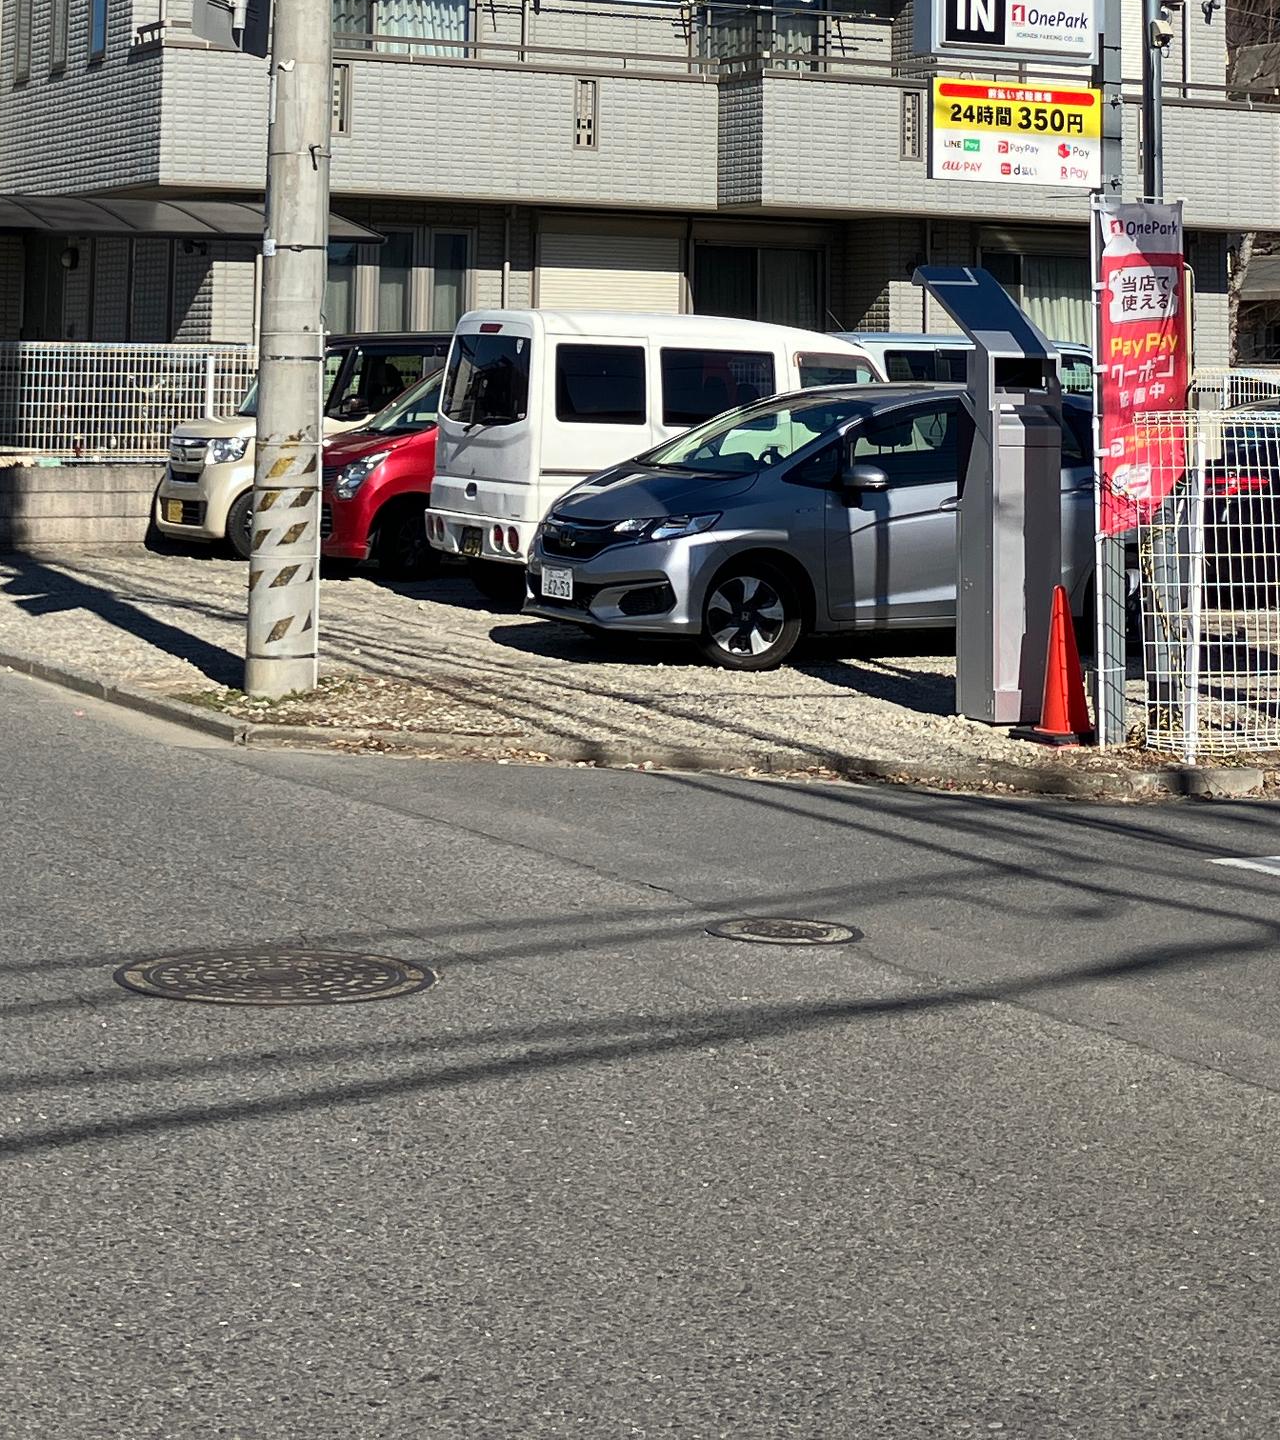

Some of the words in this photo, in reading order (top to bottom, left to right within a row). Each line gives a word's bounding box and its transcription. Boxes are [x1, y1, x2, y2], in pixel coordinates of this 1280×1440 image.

[1028, 9, 1088, 29] OnePark
[950, 103, 1012, 126] 24時間
[1017, 106, 1083, 133] 350円
[944, 140, 961, 148] LINE
[965, 141, 979, 150] Pay
[1010, 143, 1039, 154] PayPay
[1073, 148, 1090, 159] Pay
[942, 161, 962, 170] au
[964, 162, 983, 172] PAY
[1070, 167, 1089, 180] Pay
[1126, 221, 1178, 236] OnePark
[1121, 293, 1169, 312] 使える
[1110, 332, 1178, 358] PayPay
[1111, 355, 1175, 388] クーポン
